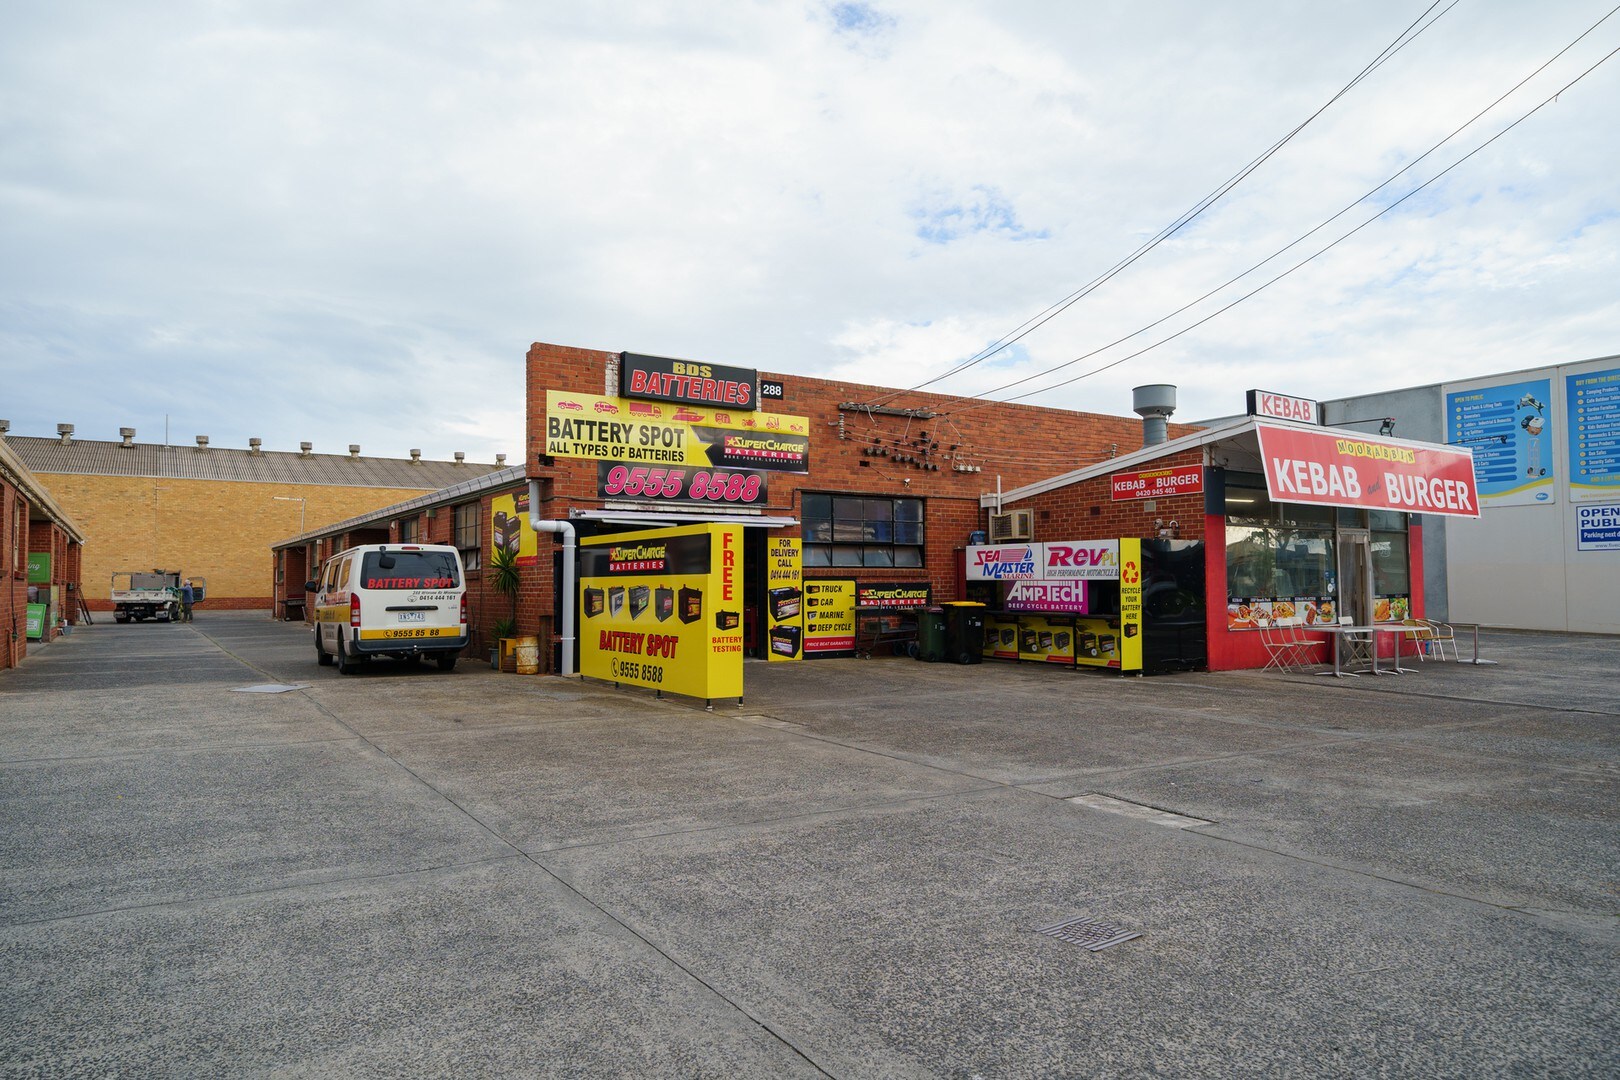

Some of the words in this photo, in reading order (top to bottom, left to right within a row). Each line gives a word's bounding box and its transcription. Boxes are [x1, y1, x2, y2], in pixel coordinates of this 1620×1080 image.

[672, 361, 712, 378] BDS
[630, 369, 751, 405] BATTERIES
[763, 384, 782, 396] 288
[1261, 394, 1311, 421] KEBAB
[548, 416, 634, 444] BATTERY
[639, 424, 685, 449] SPOT
[549, 441, 570, 454] ALL
[572, 443, 609, 457] TYPES
[611, 445, 626, 458] OF
[628, 448, 685, 462] BATTERIES
[725, 448, 802, 460] BATTERIES
[1338, 441, 1414, 462] MOORABBIN
[605, 465, 686, 498] 9555
[688, 471, 762, 502] 8588
[1114, 480, 1146, 492] KEBAB
[1156, 474, 1200, 488] BURGER
[1272, 457, 1362, 499] KEBAB
[1366, 479, 1381, 496] and
[1384, 472, 1473, 511] BURGER
[1580, 508, 1620, 517] OPEN
[771, 549, 799, 557] DELIVERY
[974, 550, 1000, 566] SEA
[610, 561, 664, 571] BATTERIES
[722, 532, 733, 601] FREE
[777, 559, 792, 567] CALL
[982, 562, 1035, 579] MASTER
[1002, 572, 1034, 580] MARINE
[368, 578, 420, 588] BATTERY
[423, 578, 454, 588] SPOT
[820, 598, 834, 606] CAR
[1122, 604, 1141, 612] BATTERY
[819, 611, 844, 619] MARINE
[1126, 612, 1138, 620] HERE
[818, 624, 832, 632] DEEP
[834, 623, 852, 631] CYCLE
[393, 630, 413, 638] 9555
[712, 636, 742, 644] BATTERY
[599, 630, 645, 655] BATTERY
[646, 633, 679, 659] SPOT
[712, 645, 742, 653] TESTING
[619, 660, 640, 679] 9555
[641, 663, 664, 684] 8588
